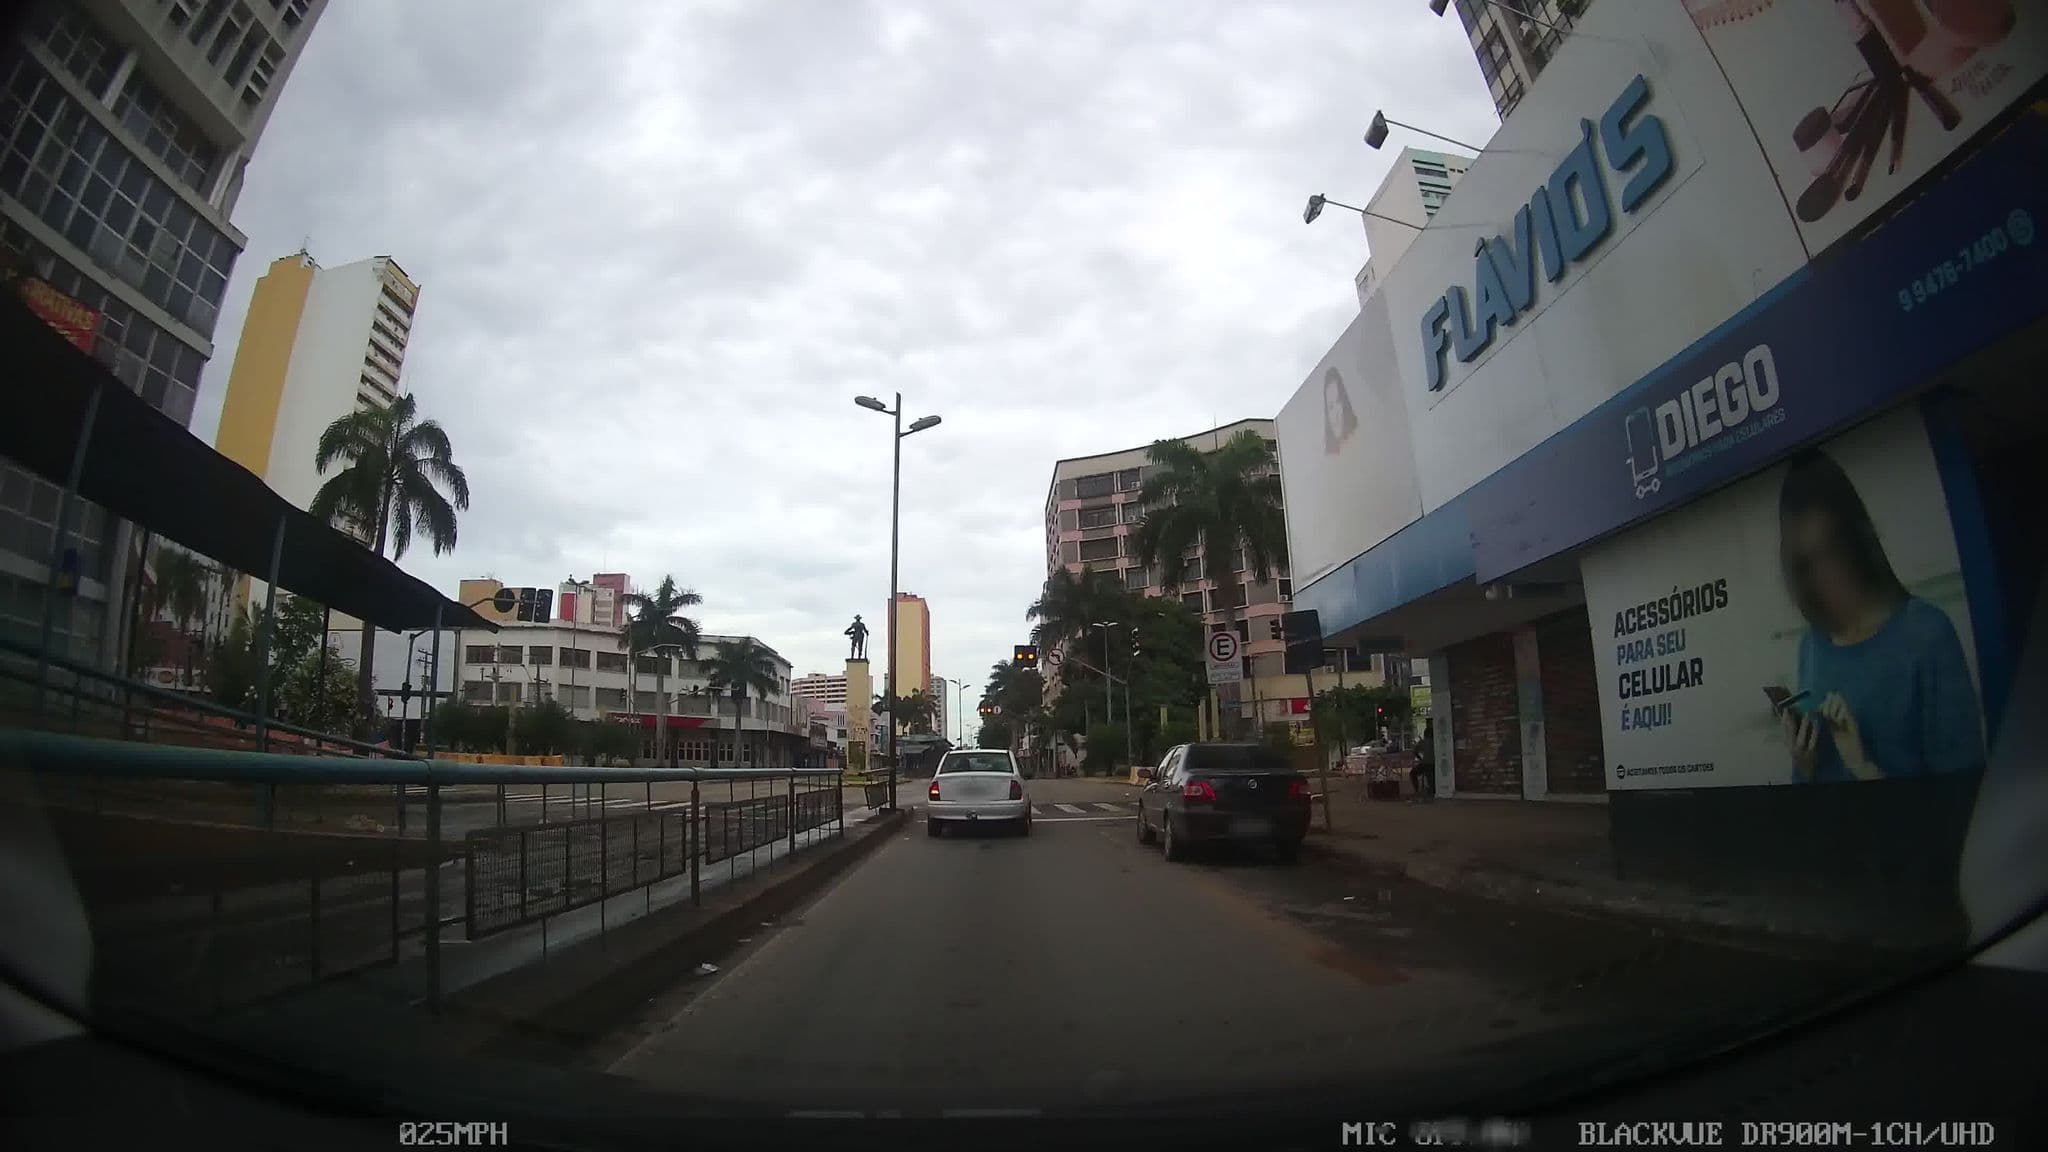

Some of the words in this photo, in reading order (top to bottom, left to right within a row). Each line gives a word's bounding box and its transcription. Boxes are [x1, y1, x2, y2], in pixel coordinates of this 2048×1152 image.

[1655, 343, 1780, 461] DIEGO
[1614, 578, 1728, 638] ACESSÓRIOS
[1217, 639, 1230, 655] E
[1617, 636, 1654, 665] PARA
[1656, 628, 1686, 656] SEU
[1619, 657, 1703, 700] CELULAR
[1621, 704, 1631, 731] É
[1632, 702, 1673, 731] AQUI!
